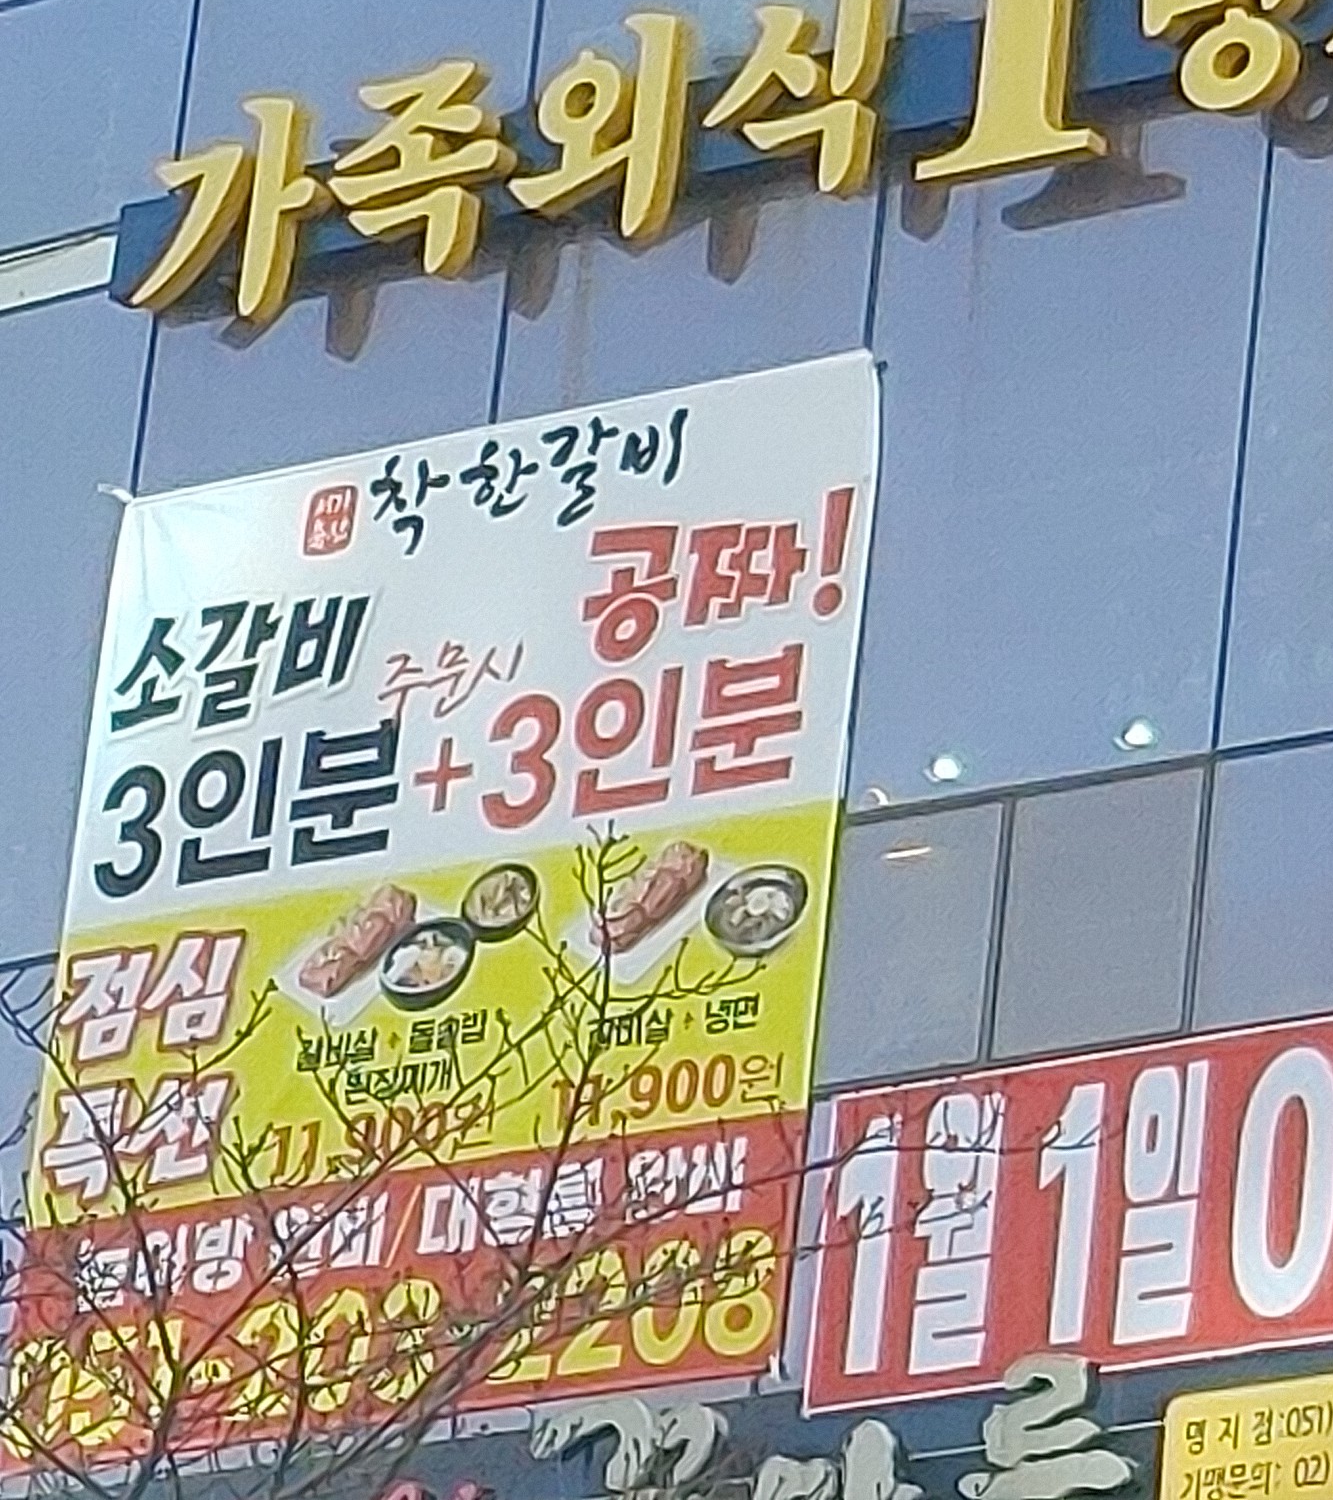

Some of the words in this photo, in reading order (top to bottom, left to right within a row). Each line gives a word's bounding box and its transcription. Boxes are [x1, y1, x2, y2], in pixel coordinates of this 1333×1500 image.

[369, 408, 690, 556] 착한갈비
[110, 595, 374, 732] 소갈비
[377, 638, 524, 724] 주문시
[582, 486, 857, 662] 공짜!
[59, 930, 246, 1065] 점심
[836, 1090, 1006, 1376] 1월
[1038, 1059, 1210, 1345] 1일
